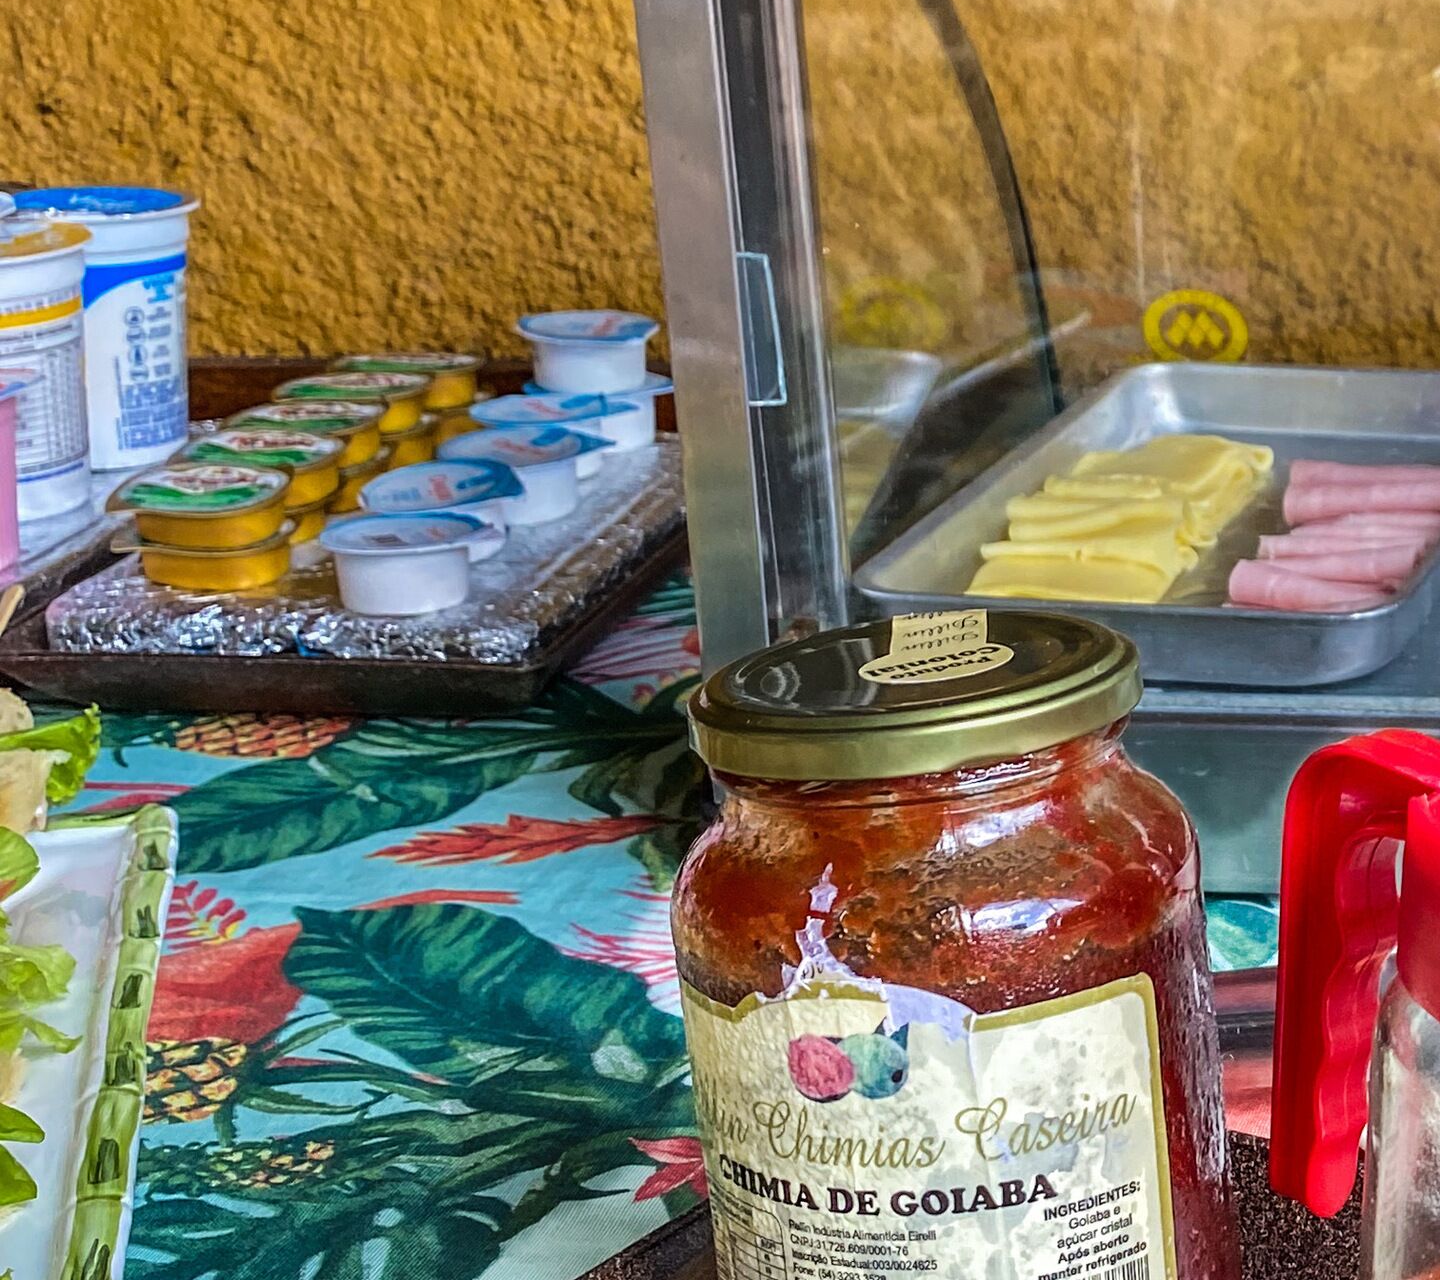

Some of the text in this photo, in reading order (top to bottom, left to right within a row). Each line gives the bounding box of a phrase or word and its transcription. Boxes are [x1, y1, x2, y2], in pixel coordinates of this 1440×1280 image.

[864, 646, 1000, 677] Colonial
[890, 656, 993, 680] Produto
[753, 1101, 946, 1169] Chimias
[955, 1092, 1137, 1161] Caseira
[719, 1153, 820, 1211] CHIMIA
[827, 1187, 880, 1217] DE
[890, 1173, 1059, 1217] GOIABA
[1044, 1180, 1141, 1221] INGREDIENTES:
[1057, 1213, 1134, 1250] açúcar cristal
[1068, 1205, 1121, 1230] Goiaba e
[1058, 1234, 1130, 1265] Após aberto
[1086, 1240, 1148, 1272] refrigerado
